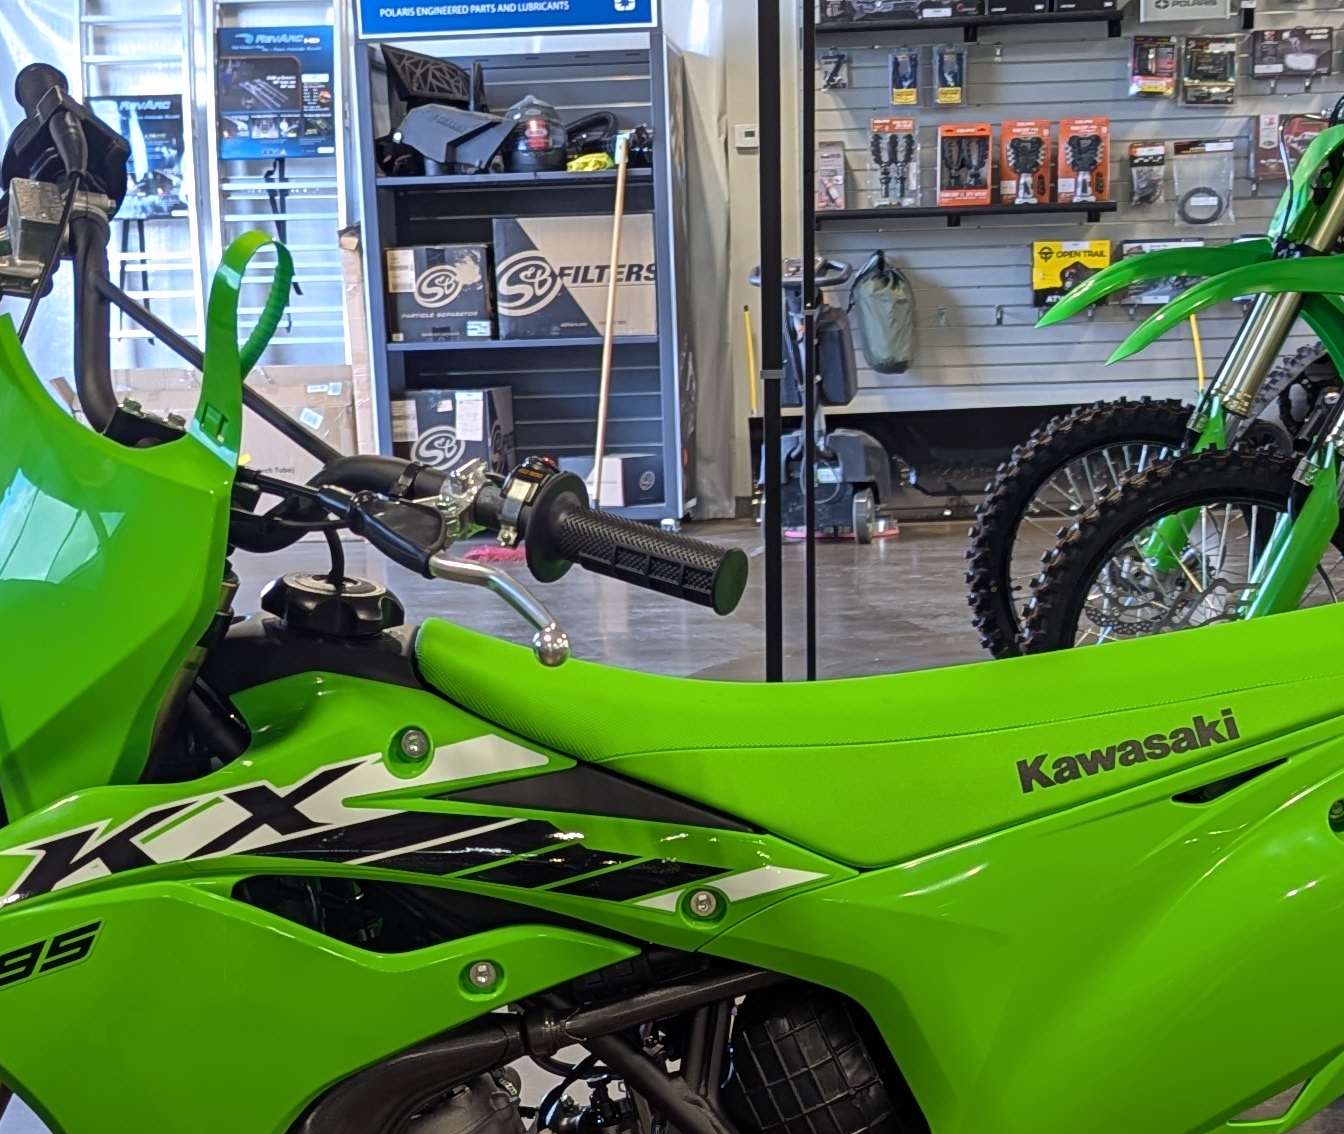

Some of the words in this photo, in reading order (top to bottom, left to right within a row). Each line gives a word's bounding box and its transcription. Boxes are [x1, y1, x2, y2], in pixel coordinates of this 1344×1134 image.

[379, 8, 415, 18] POLARIS
[416, 5, 468, 16] ENGINEERED
[469, 4, 496, 14] PARTS
[497, 3, 516, 13] AND
[517, 1, 569, 12] LUBRICANTS
[1055, 250, 1082, 259] OPEN
[1083, 249, 1107, 258] TRAIL
[1018, 707, 1241, 796] Kawasaki
[8, 759, 369, 903] KX
